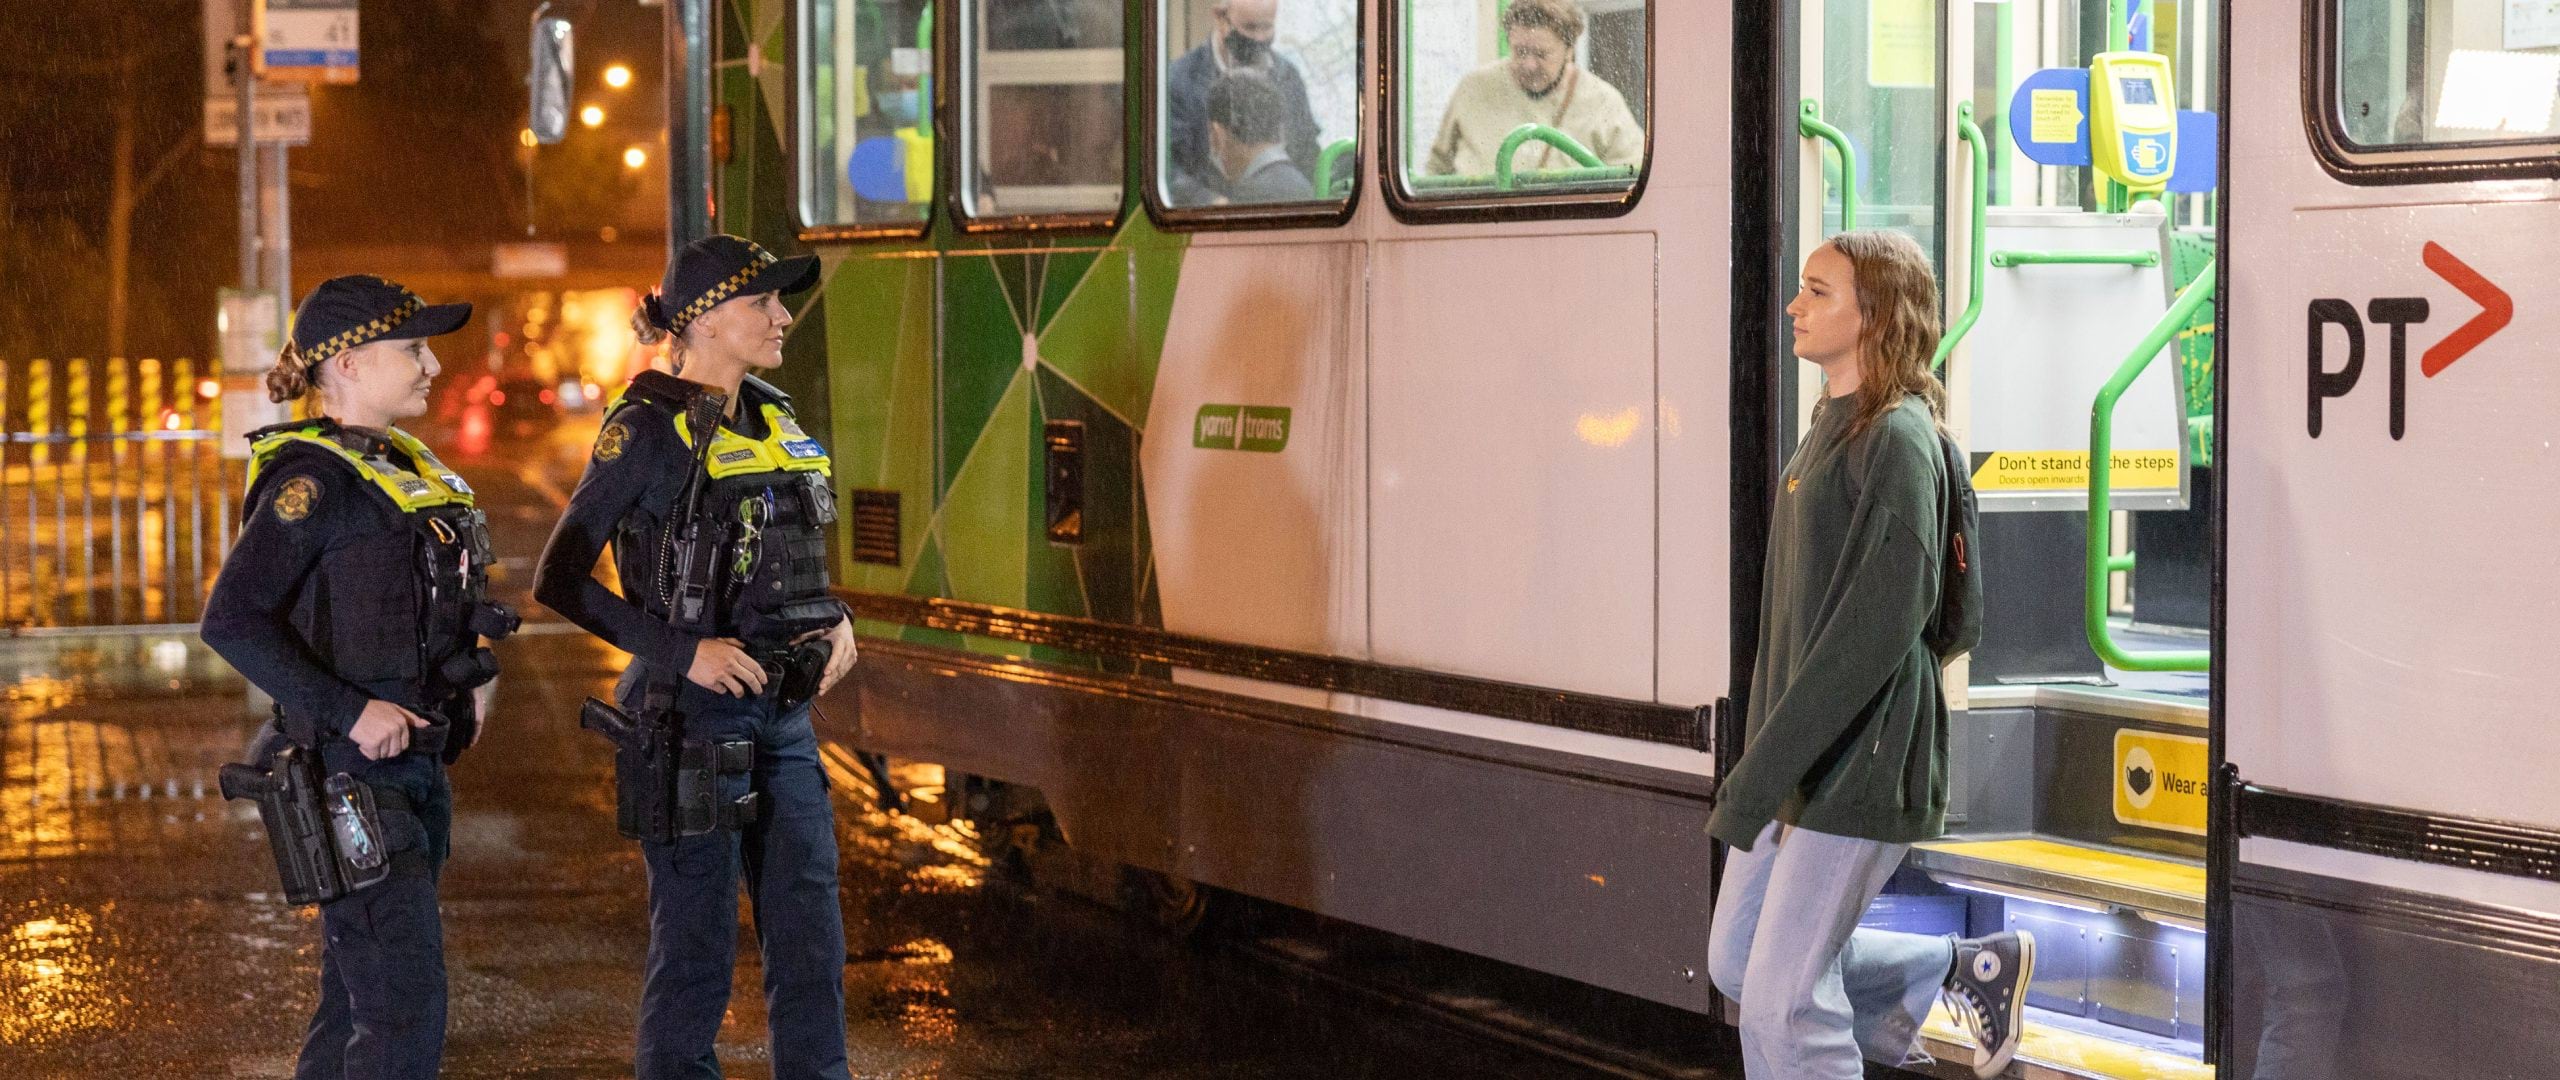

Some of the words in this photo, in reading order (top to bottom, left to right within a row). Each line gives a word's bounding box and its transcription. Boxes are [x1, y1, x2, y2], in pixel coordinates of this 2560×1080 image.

[1200, 415, 1233, 443] yarra
[1246, 413, 1283, 440] trams
[1999, 456, 2037, 471] Don't
[2041, 455, 2081, 471] stand
[2134, 455, 2174, 472] steps
[1999, 474, 2026, 485] Doors
[2027, 476, 2050, 486] open
[2050, 474, 2086, 484] inwards
[2161, 771, 2197, 795] Wear
